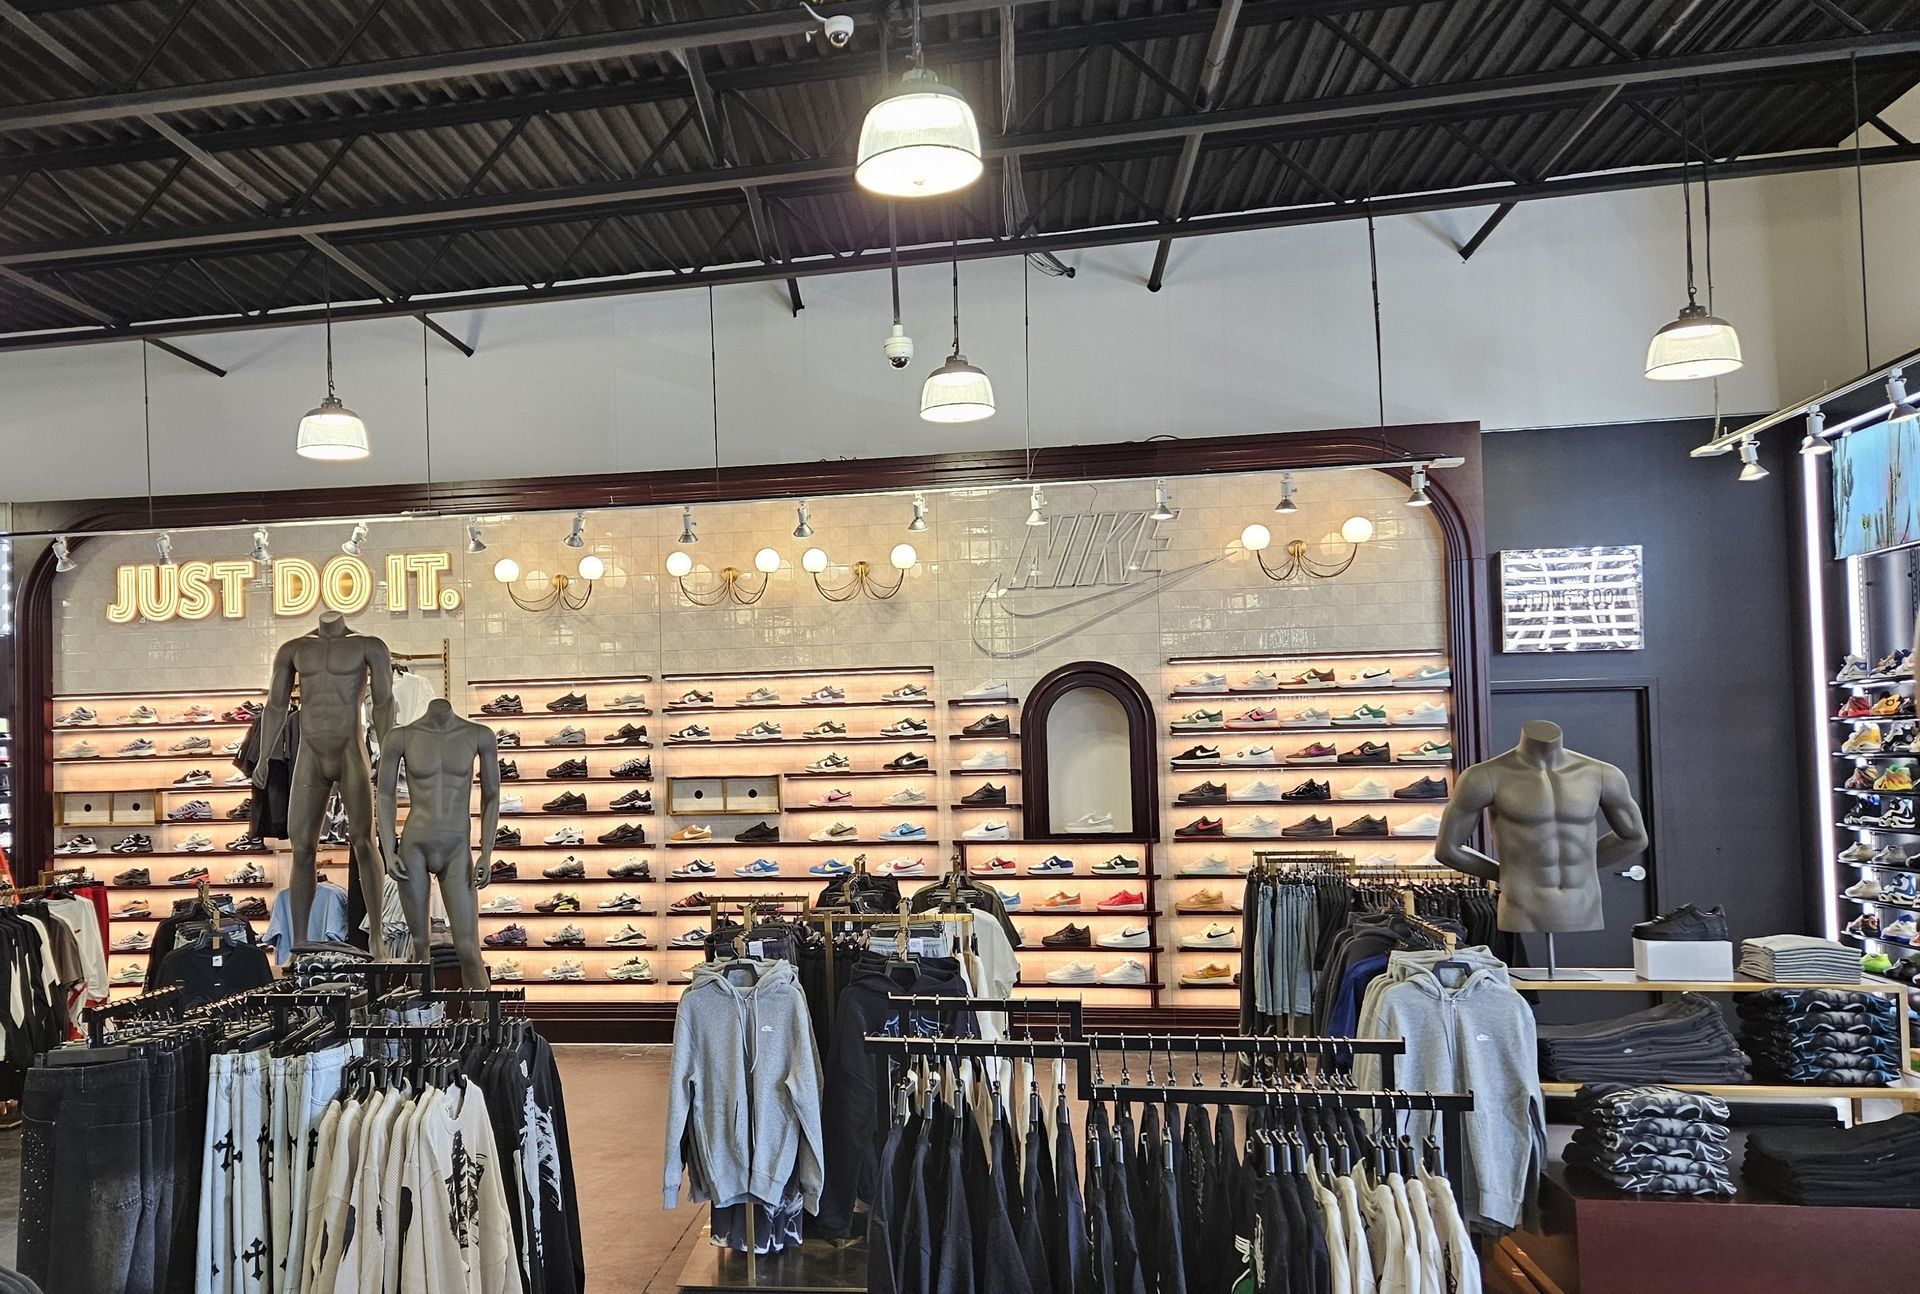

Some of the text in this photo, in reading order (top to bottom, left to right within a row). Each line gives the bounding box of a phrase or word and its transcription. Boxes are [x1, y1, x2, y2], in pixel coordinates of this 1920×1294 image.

[1007, 508, 1182, 590] NIKE
[107, 552, 462, 623] JUST DO IT.
